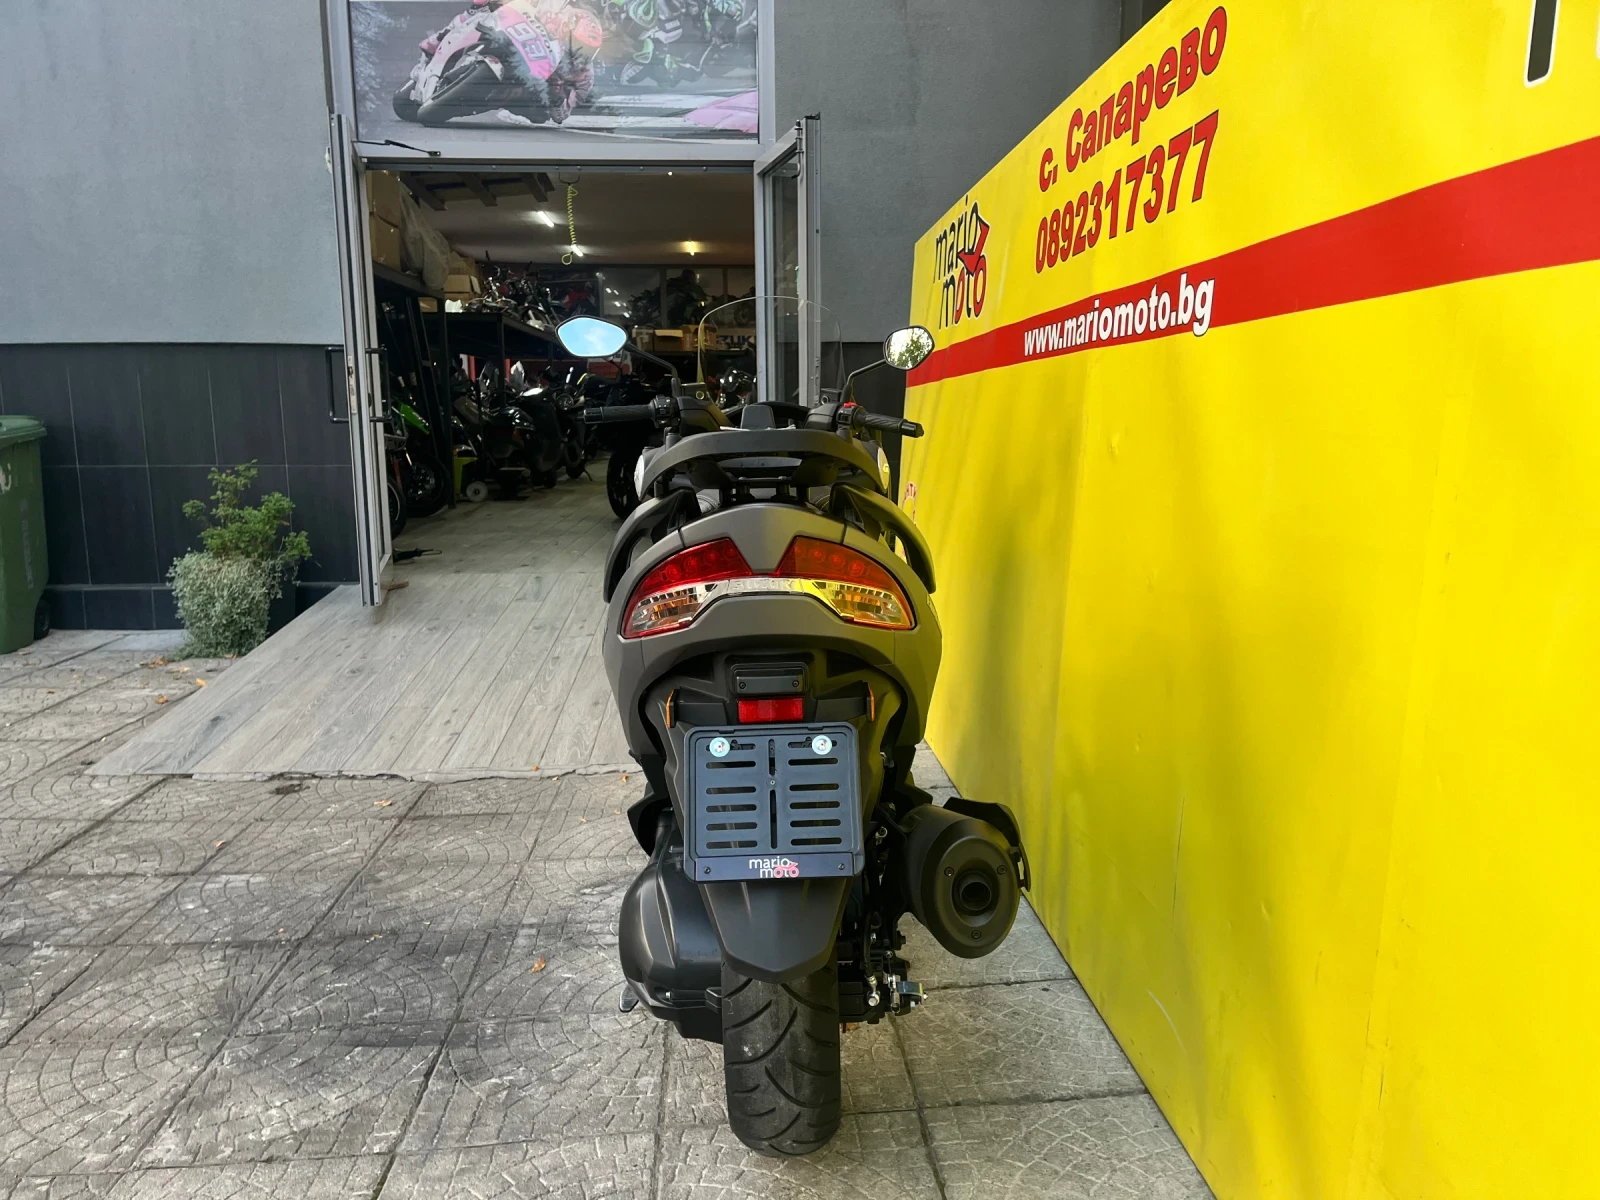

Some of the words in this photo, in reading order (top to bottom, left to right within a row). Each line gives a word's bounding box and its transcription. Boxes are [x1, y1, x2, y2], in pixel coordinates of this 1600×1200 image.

[505, 20, 549, 60] 93
[1066, 5, 1228, 173] Сапарево
[1035, 109, 1220, 274] 0892317377
[933, 194, 980, 284] mario
[938, 253, 987, 330] moto
[1024, 272, 1215, 357] www.mariomoto.bg
[749, 855, 790, 869] mario
[759, 867, 799, 878] moto
